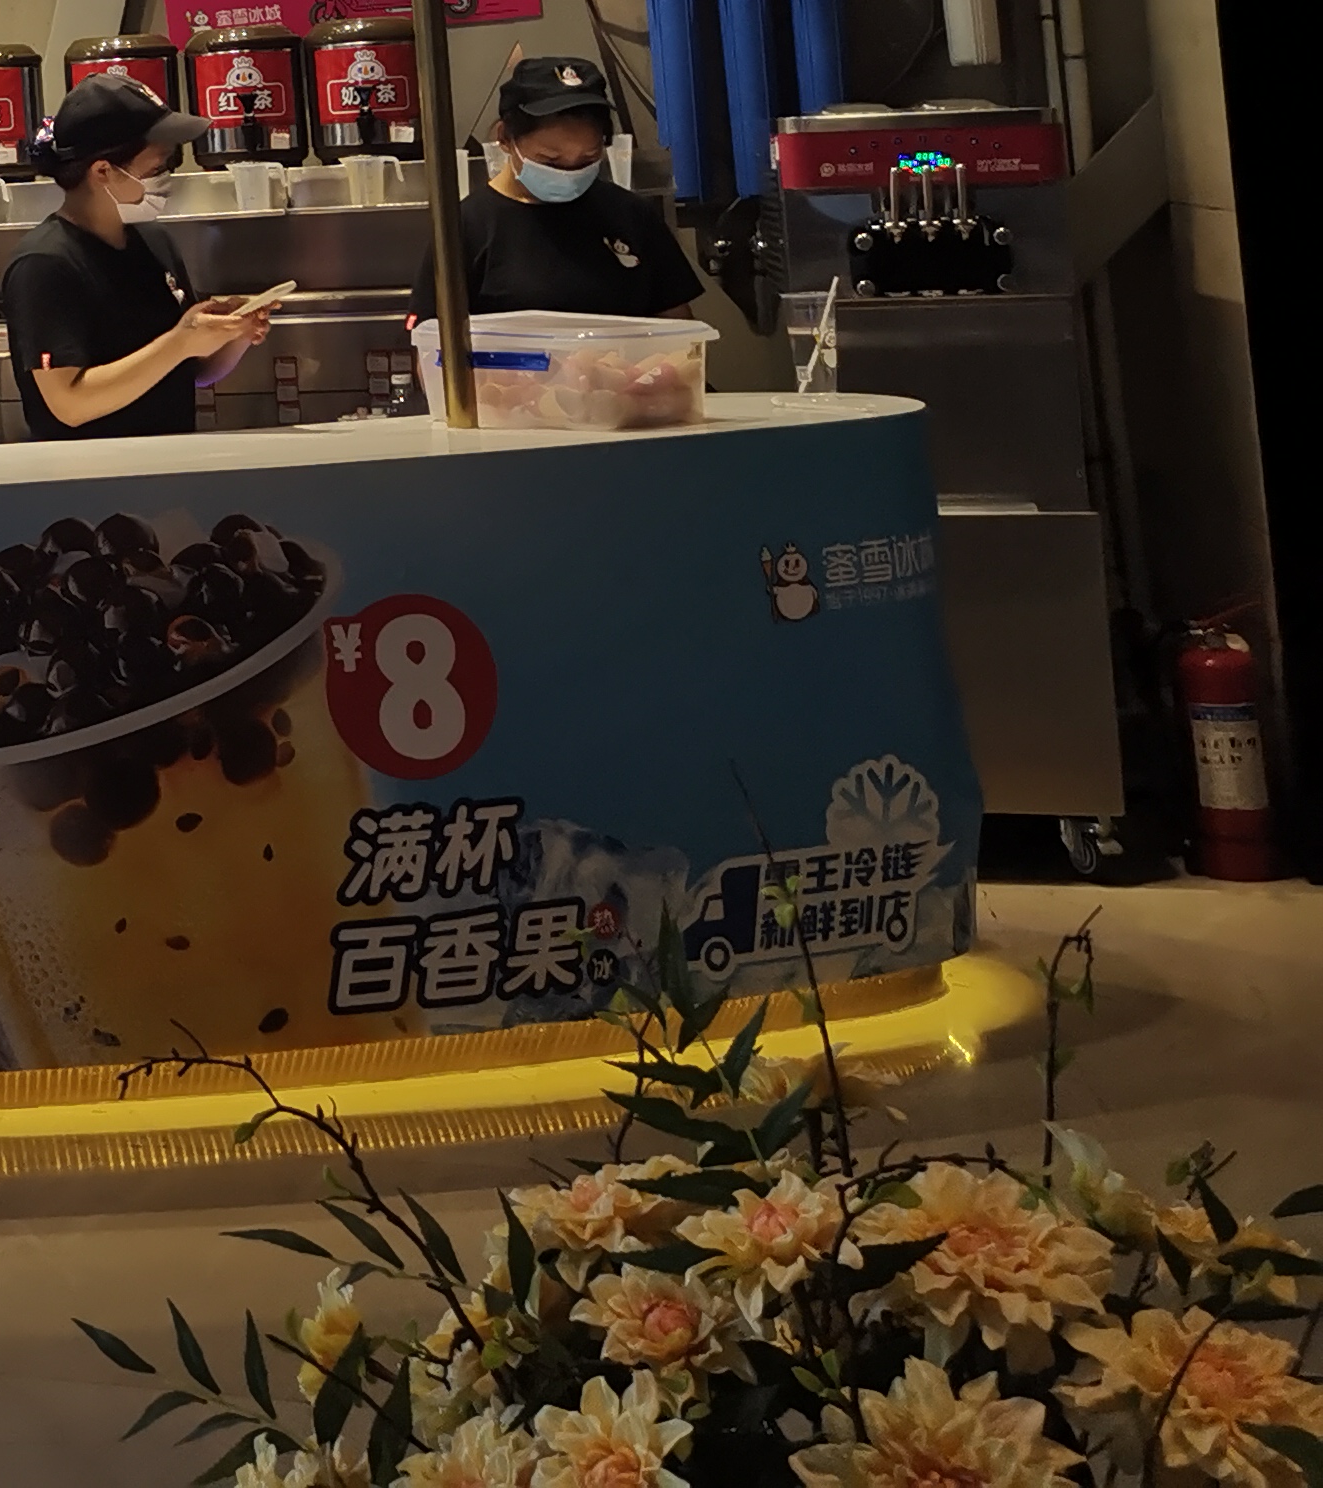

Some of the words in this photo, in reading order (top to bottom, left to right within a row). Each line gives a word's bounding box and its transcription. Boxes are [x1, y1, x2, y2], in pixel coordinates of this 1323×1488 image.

[217, 89, 273, 113] 红茶
[341, 83, 396, 107] 奶茶
[331, 613, 467, 762] ¥8
[344, 802, 522, 901] 满杯
[333, 903, 581, 1009] 百香果
